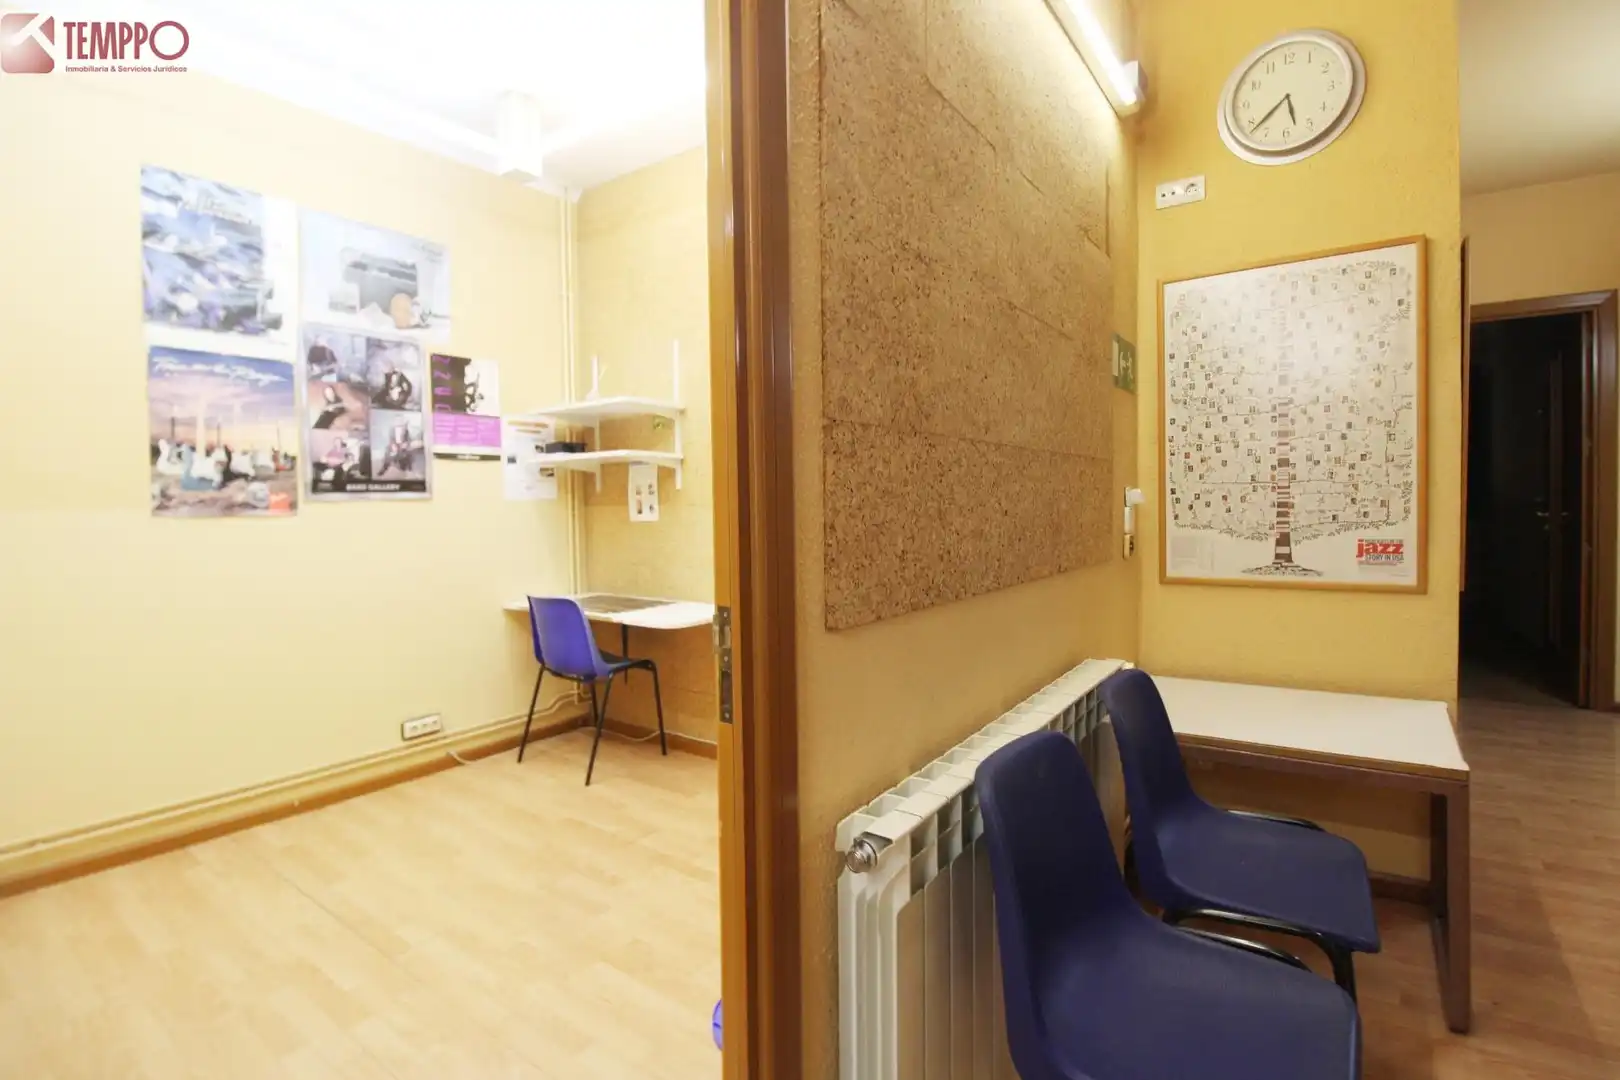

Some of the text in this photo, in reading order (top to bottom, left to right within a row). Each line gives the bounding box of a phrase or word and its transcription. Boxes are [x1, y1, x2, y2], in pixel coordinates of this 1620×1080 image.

[1283, 52, 1296, 65] 12
[1266, 61, 1275, 74] 11
[1321, 62, 1330, 74] 2
[1251, 80, 1261, 91] 10
[1327, 80, 1335, 91] 3
[1306, 117, 1314, 131] 5
[1282, 127, 1290, 138] 6
[1356, 539, 1404, 558] jazz
